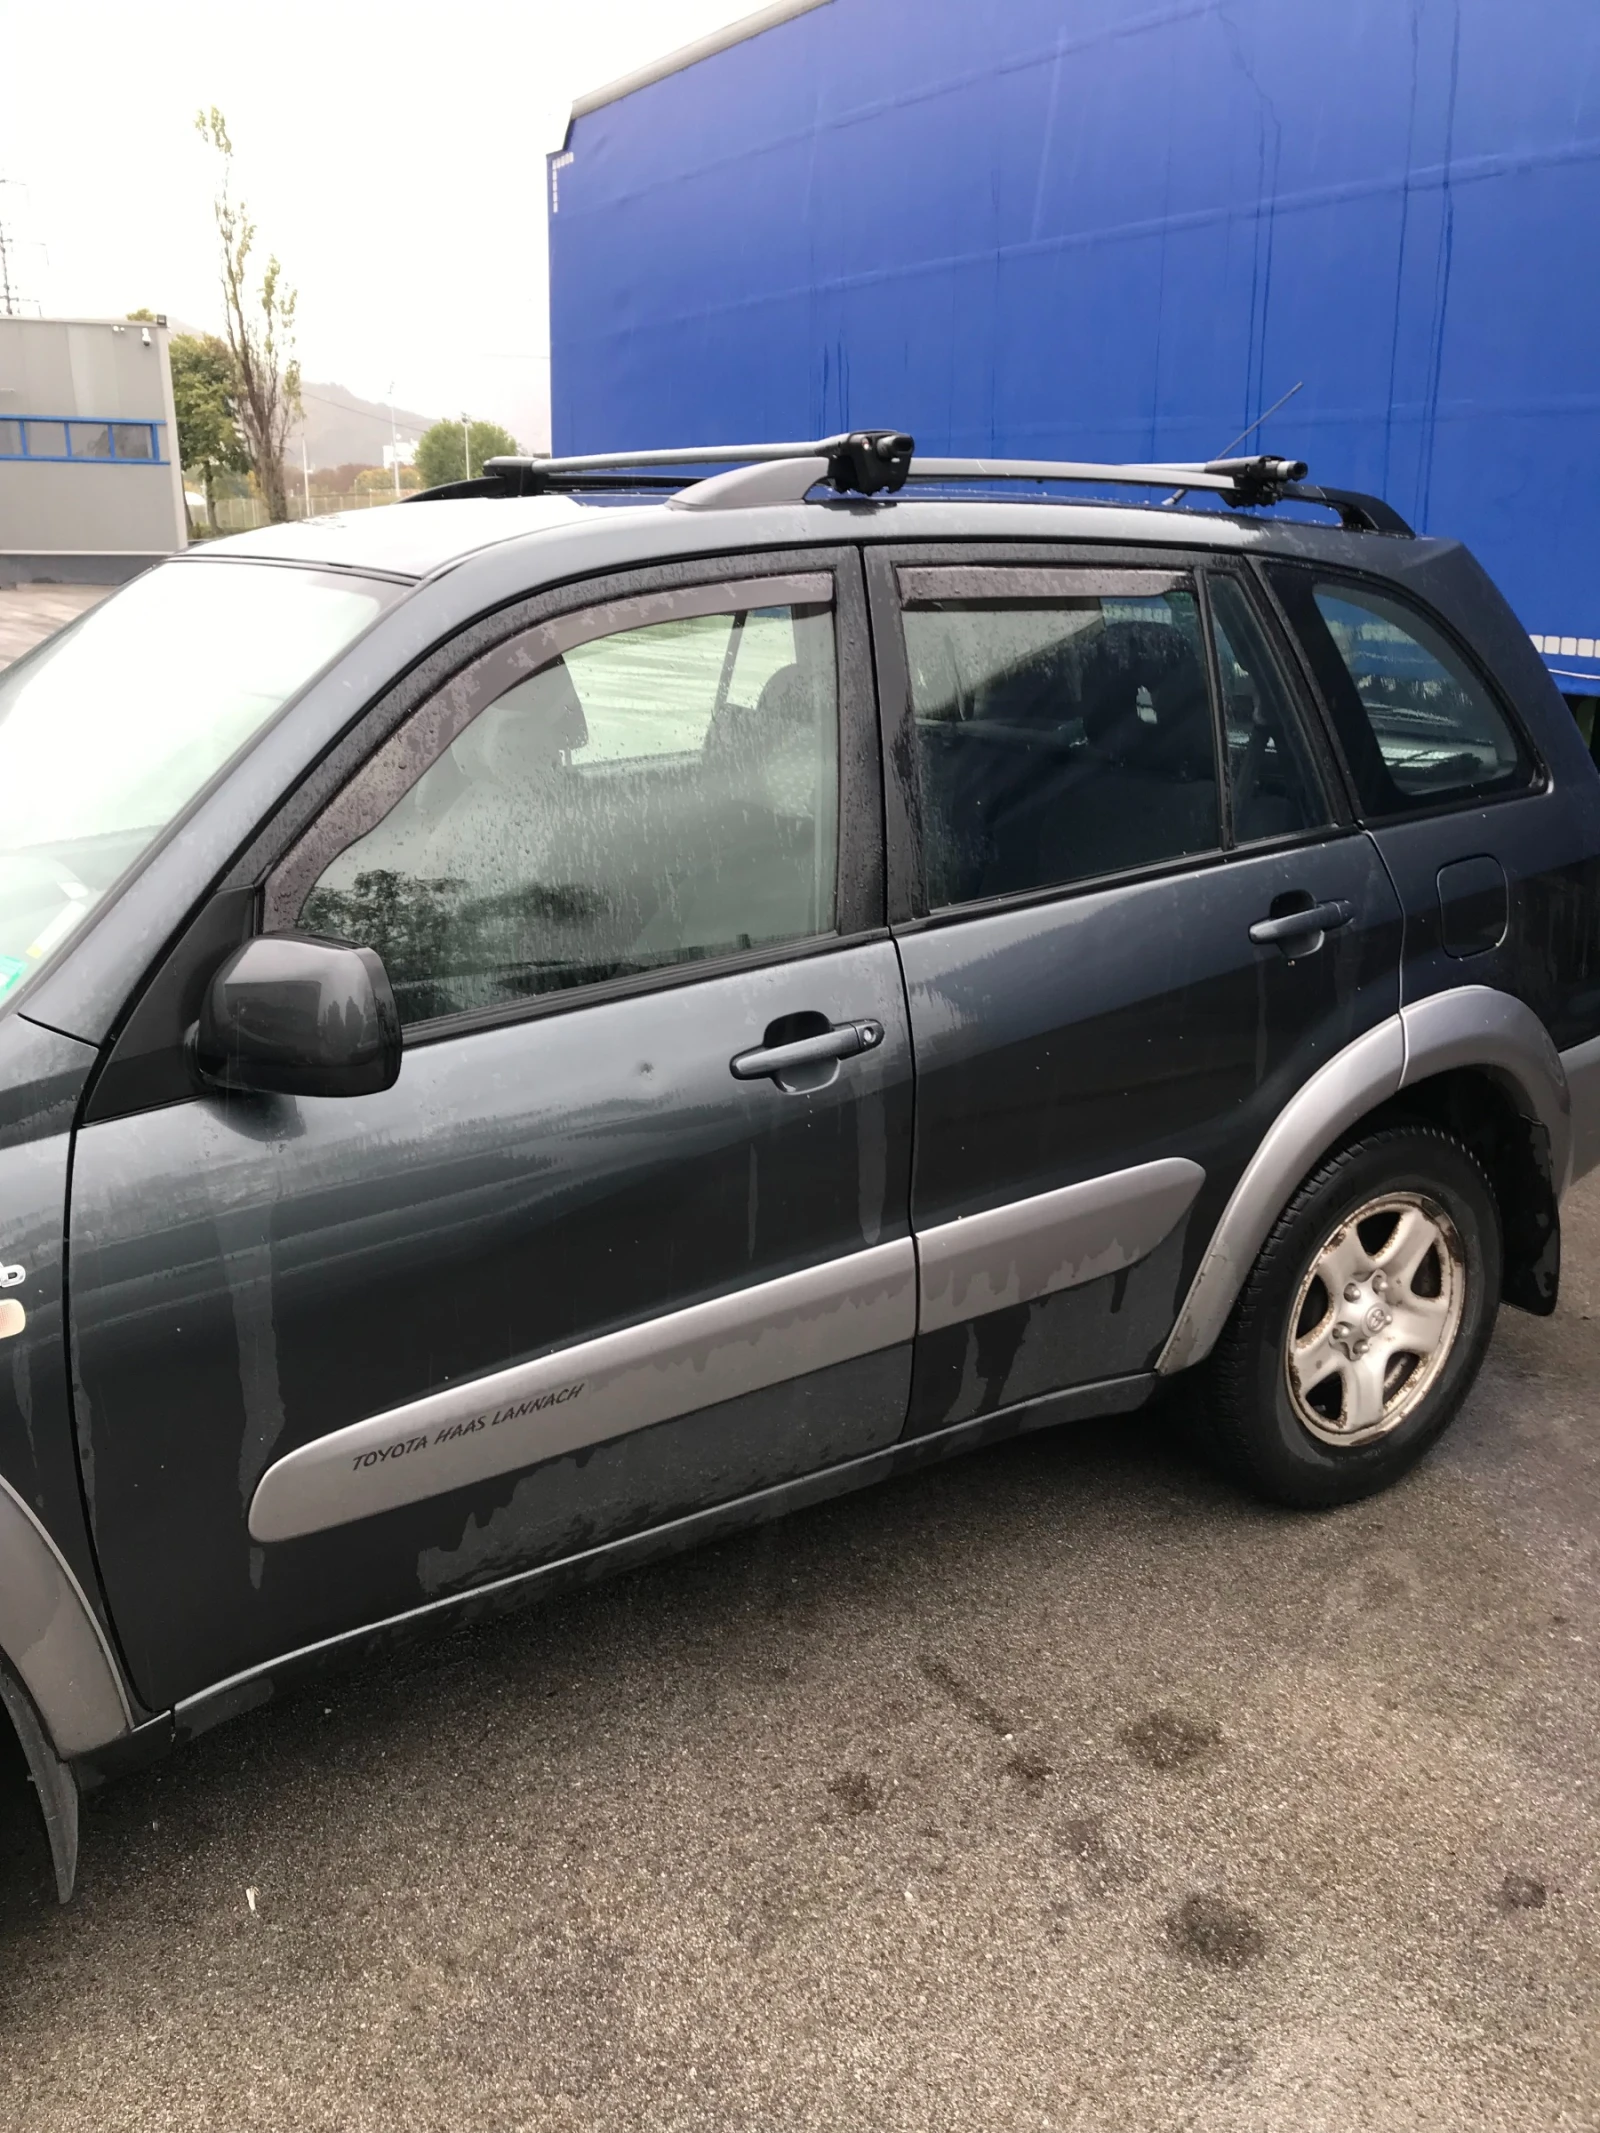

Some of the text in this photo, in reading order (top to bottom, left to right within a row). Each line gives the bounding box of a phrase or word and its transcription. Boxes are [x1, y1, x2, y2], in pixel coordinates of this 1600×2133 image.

[352, 1382, 585, 1471] TOYOTA HAAS LANNACH
